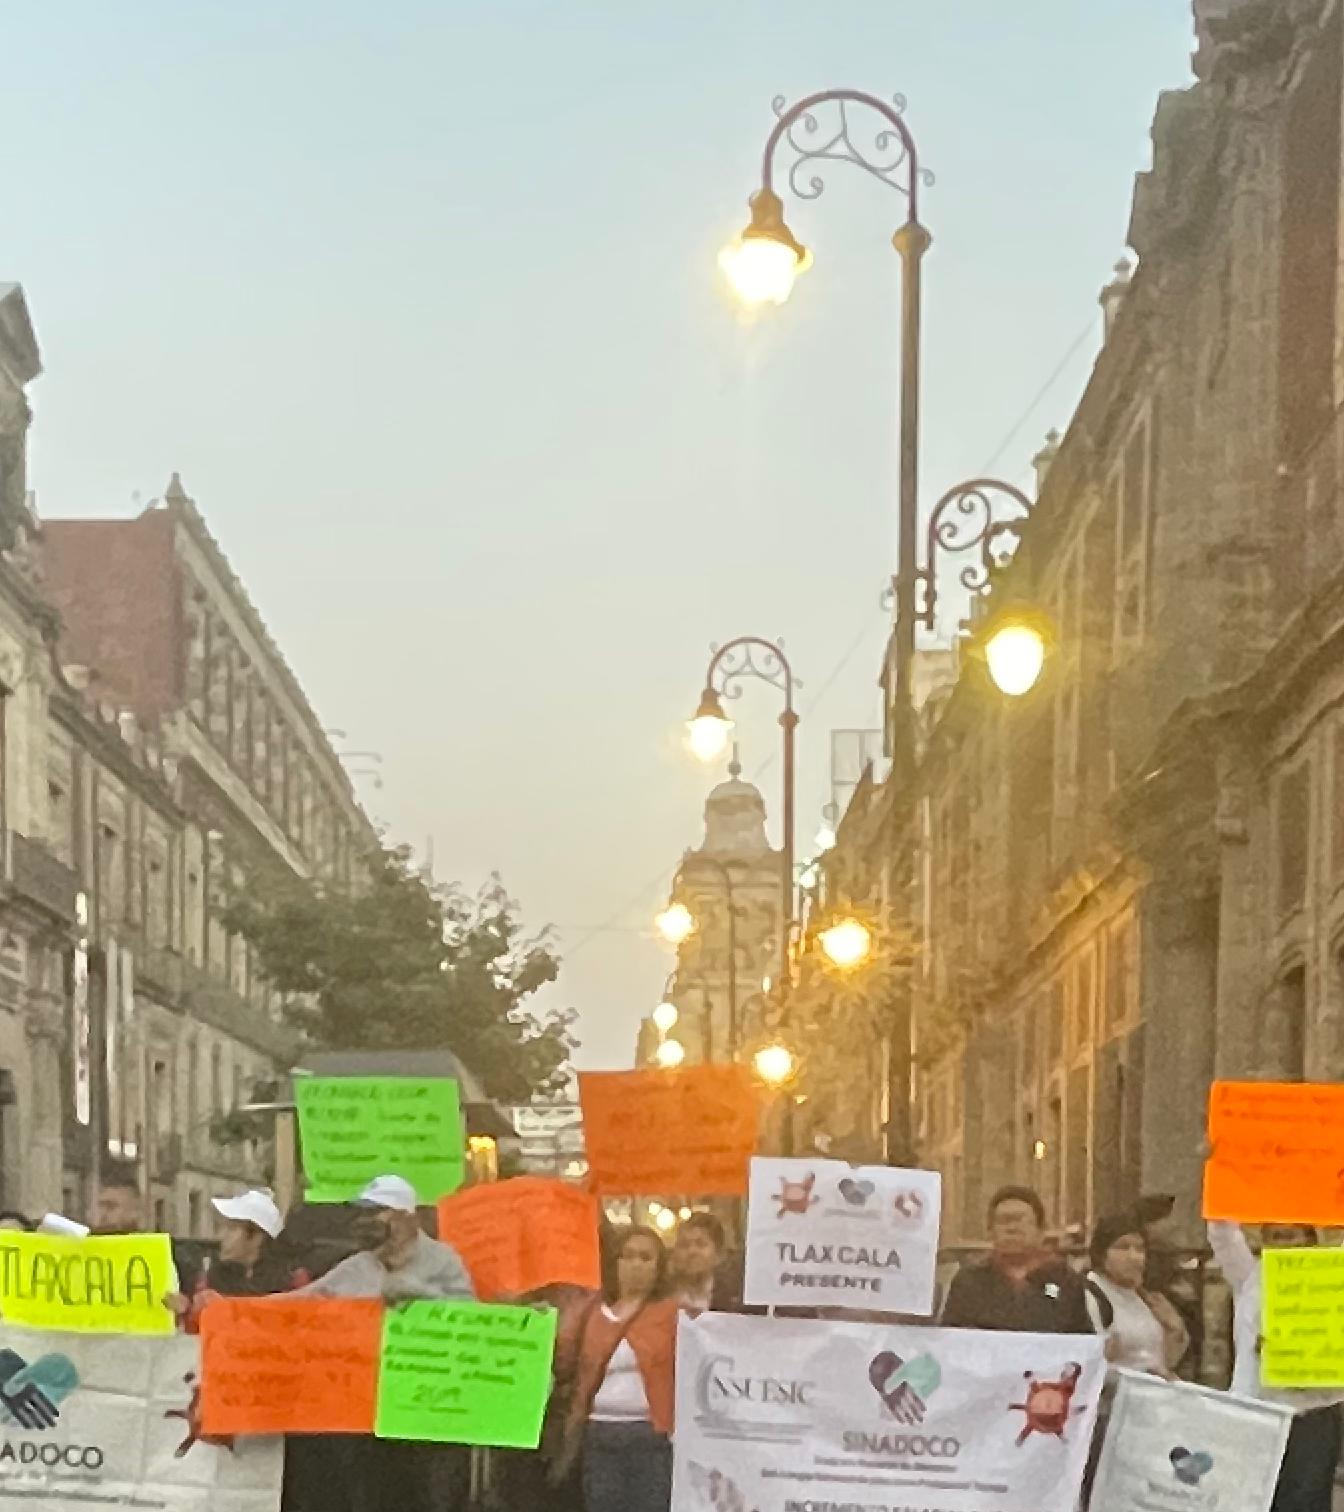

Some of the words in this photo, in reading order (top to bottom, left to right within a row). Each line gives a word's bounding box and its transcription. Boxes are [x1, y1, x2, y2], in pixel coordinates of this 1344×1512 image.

[776, 1242, 901, 1269] TLAXCALA
[780, 1272, 882, 1292] PRESENTE
[842, 1430, 960, 1458] SINADOCO
